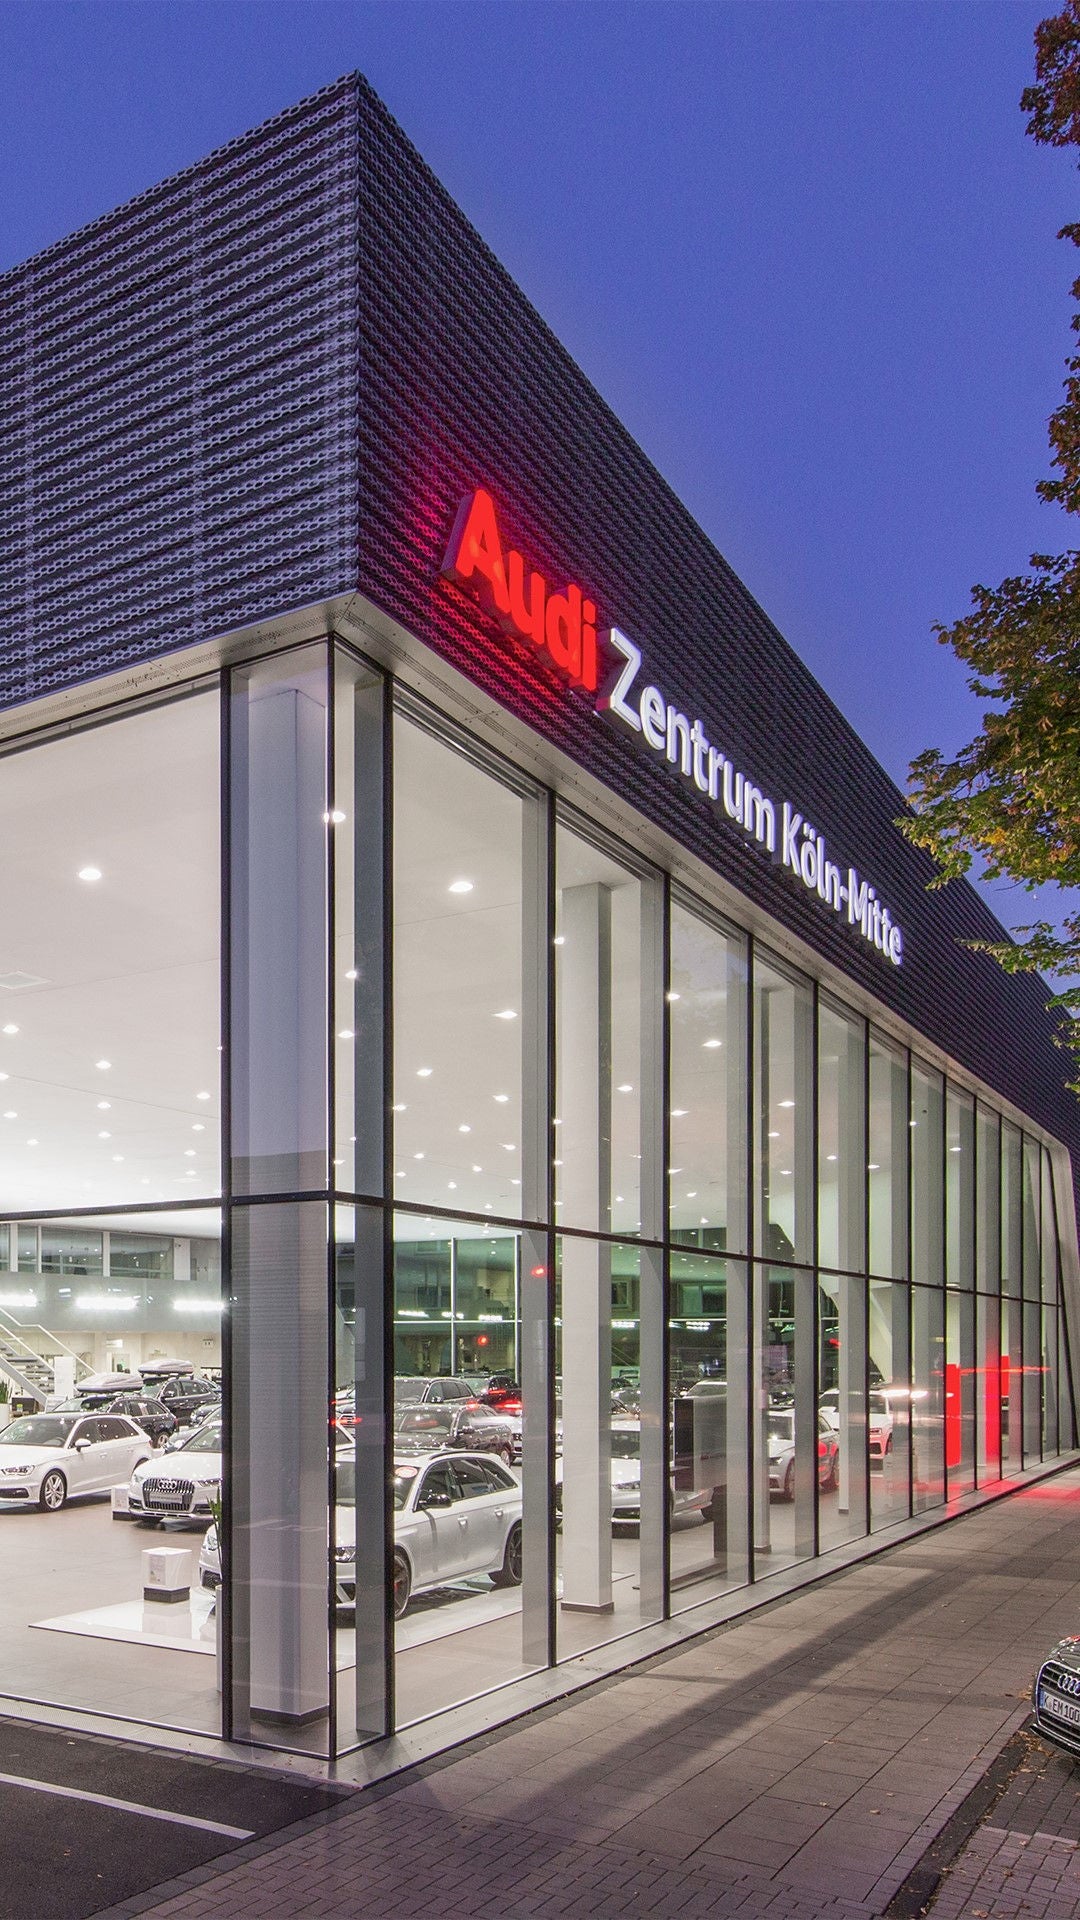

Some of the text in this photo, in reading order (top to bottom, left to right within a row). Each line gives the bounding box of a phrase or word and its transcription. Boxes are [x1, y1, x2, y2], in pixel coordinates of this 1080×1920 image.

[455, 488, 904, 966] Audi Zentrum Köln-Mitte
